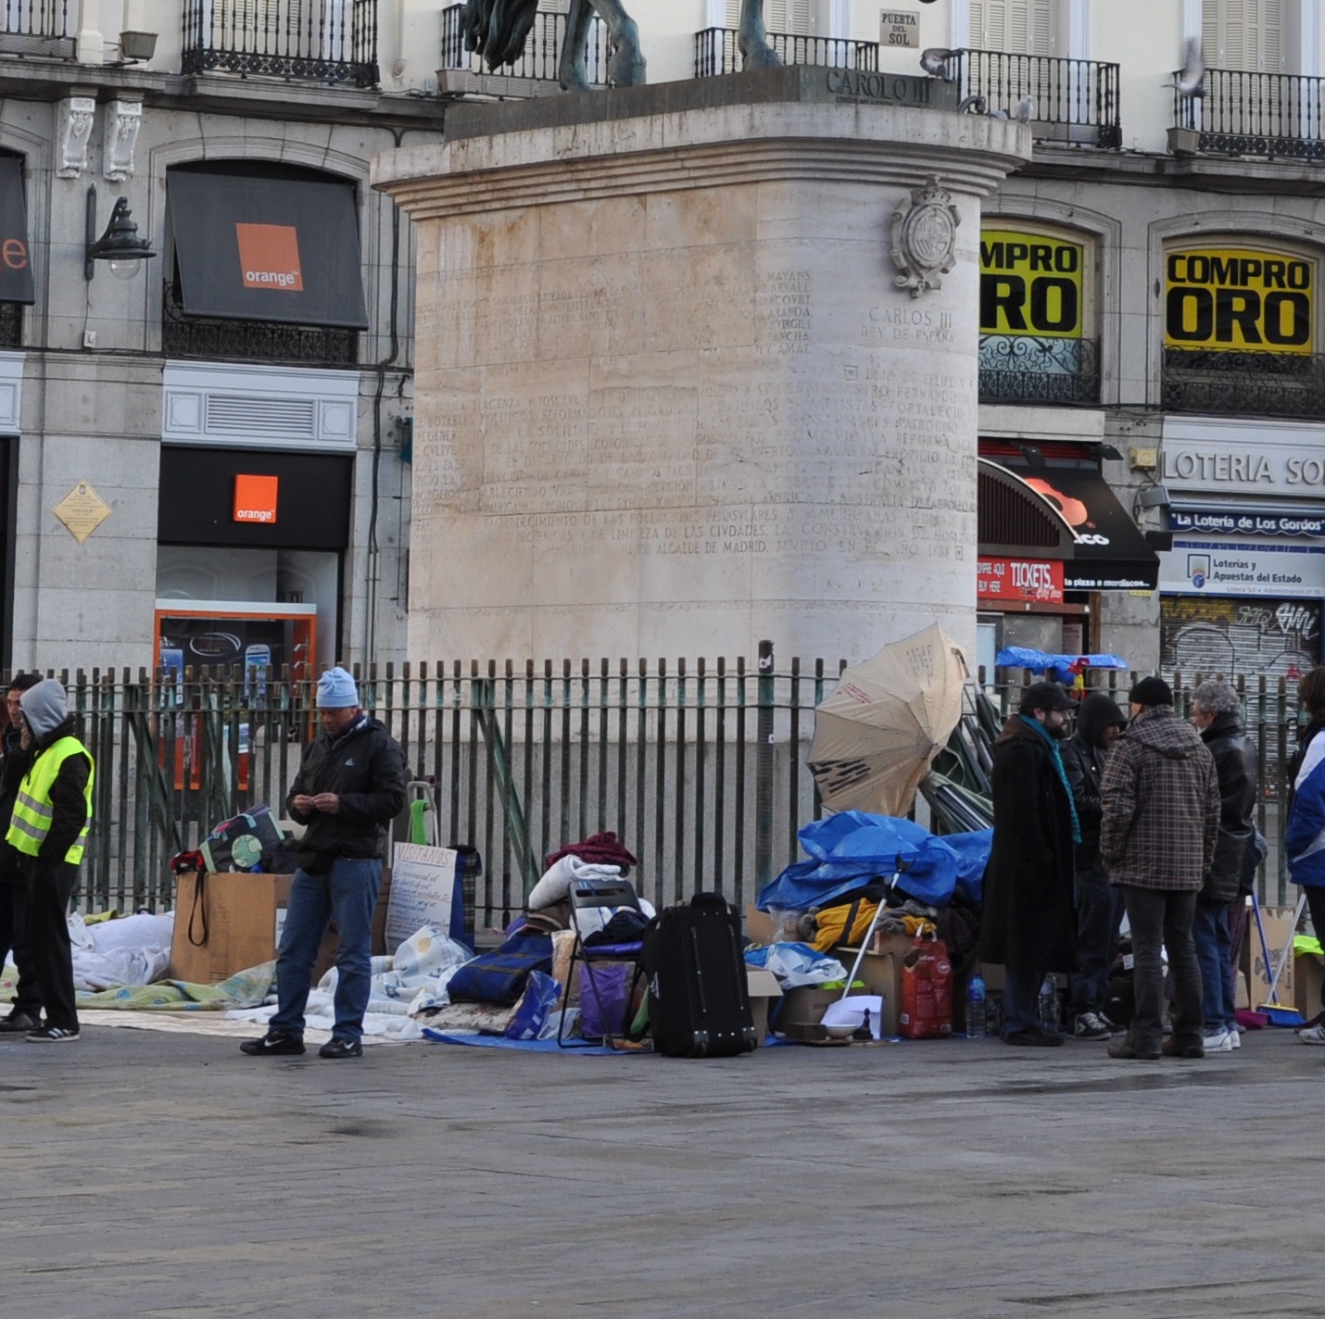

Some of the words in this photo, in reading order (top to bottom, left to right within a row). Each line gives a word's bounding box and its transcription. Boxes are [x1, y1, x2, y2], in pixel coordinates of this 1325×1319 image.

[882, 13, 916, 26] PUERTA
[892, 25, 907, 33] DEL
[889, 33, 910, 46] SOL
[980, 239, 1078, 273] MPRO
[245, 268, 295, 286] orange
[1166, 253, 1311, 291] COMPRO
[980, 276, 1078, 333] RO
[869, 305, 932, 327] CARLOS
[939, 312, 953, 329] III
[1165, 287, 1311, 345] ORO
[860, 325, 885, 340] REY
[893, 328, 909, 341] DE
[1162, 451, 1276, 484] LOTERIA
[237, 509, 273, 521] orange
[1237, 517, 1254, 529] de
[1256, 517, 1277, 530] Los
[1250, 562, 1257, 570] y
[1064, 578, 1073, 586] la
[1073, 578, 1096, 588] pizza
[1213, 571, 1256, 584] Apuestas
[1257, 573, 1271, 584] del
[1271, 574, 1303, 585] Estado
